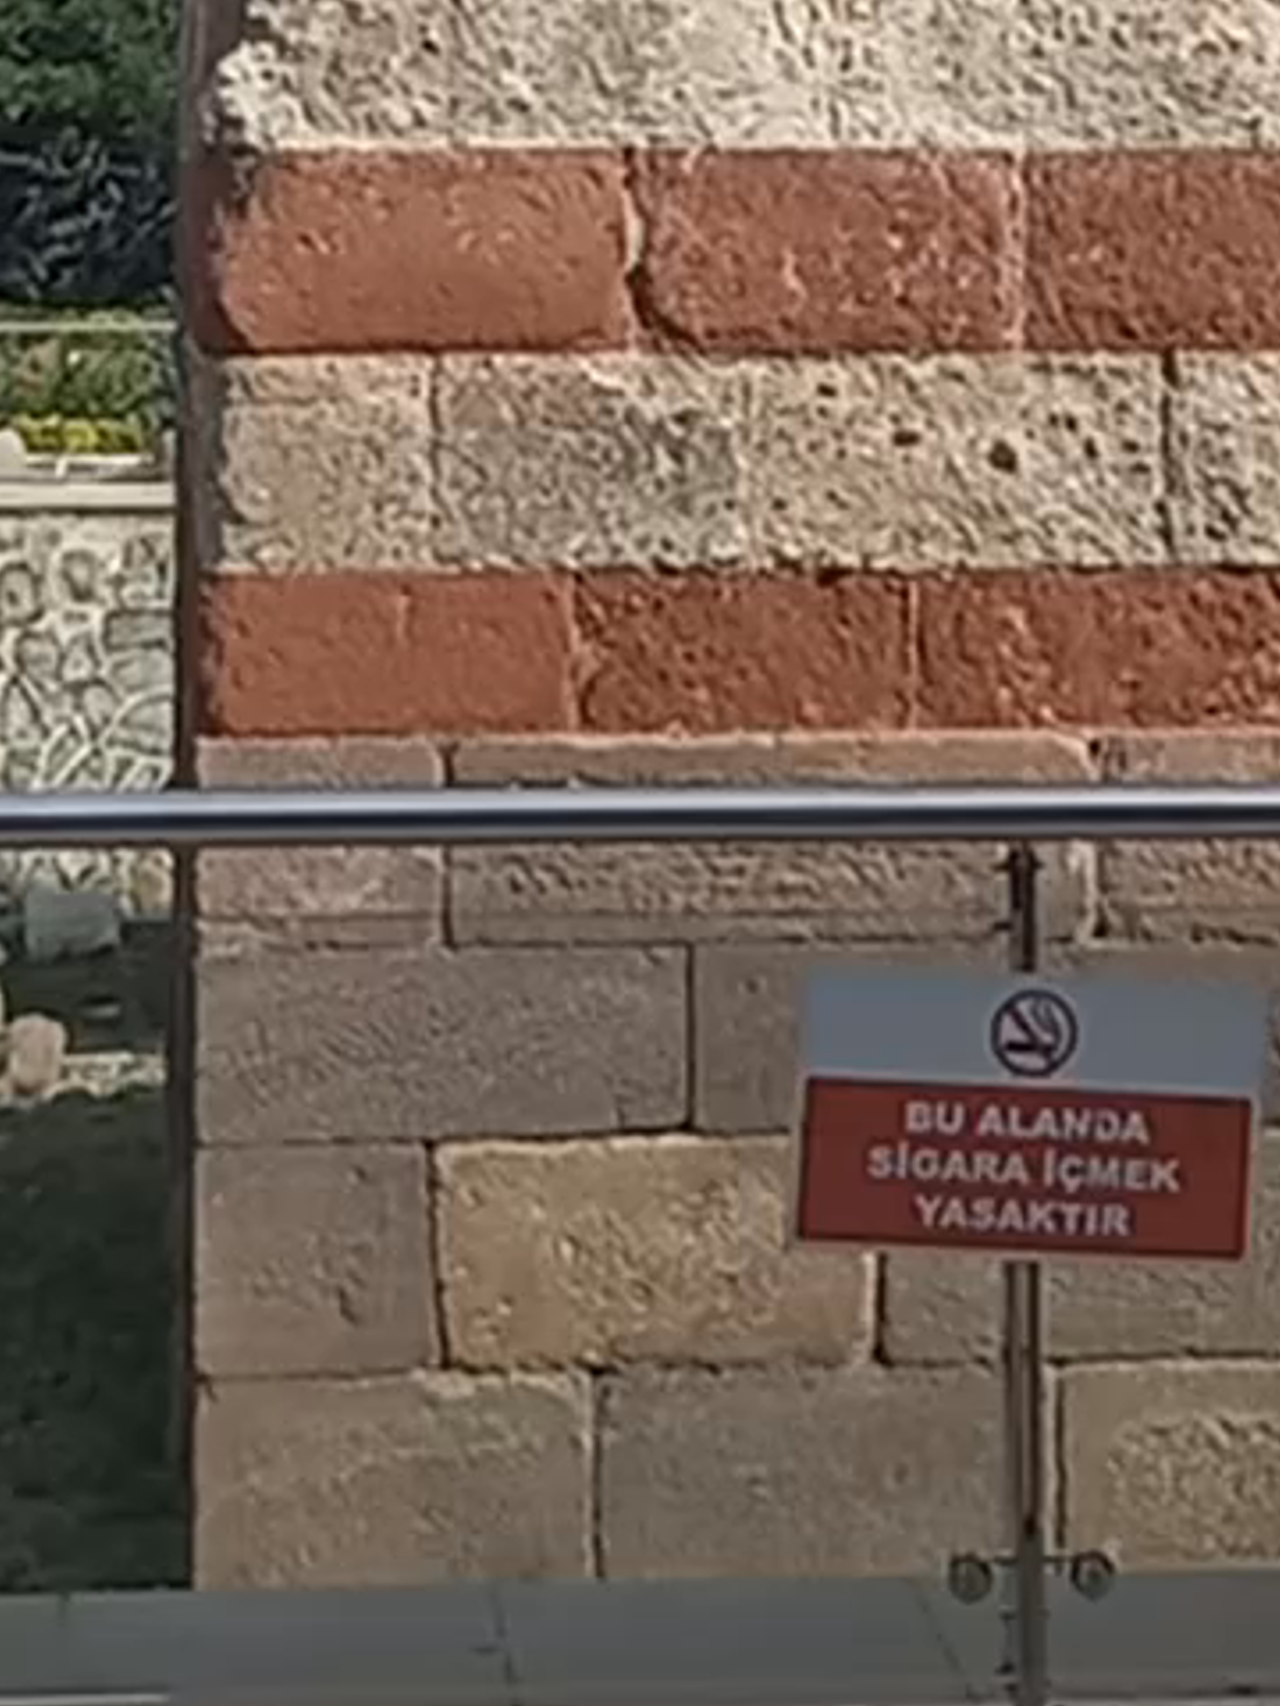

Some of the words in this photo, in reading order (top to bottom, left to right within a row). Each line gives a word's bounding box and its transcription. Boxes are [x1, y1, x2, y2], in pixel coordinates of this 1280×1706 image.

[904, 1100, 965, 1136] BU
[976, 1105, 1150, 1144] ALANDA
[867, 1142, 1028, 1186] SİGARA
[1044, 1147, 1181, 1193] İÇMEK
[915, 1195, 1131, 1236] YASAKTIR
